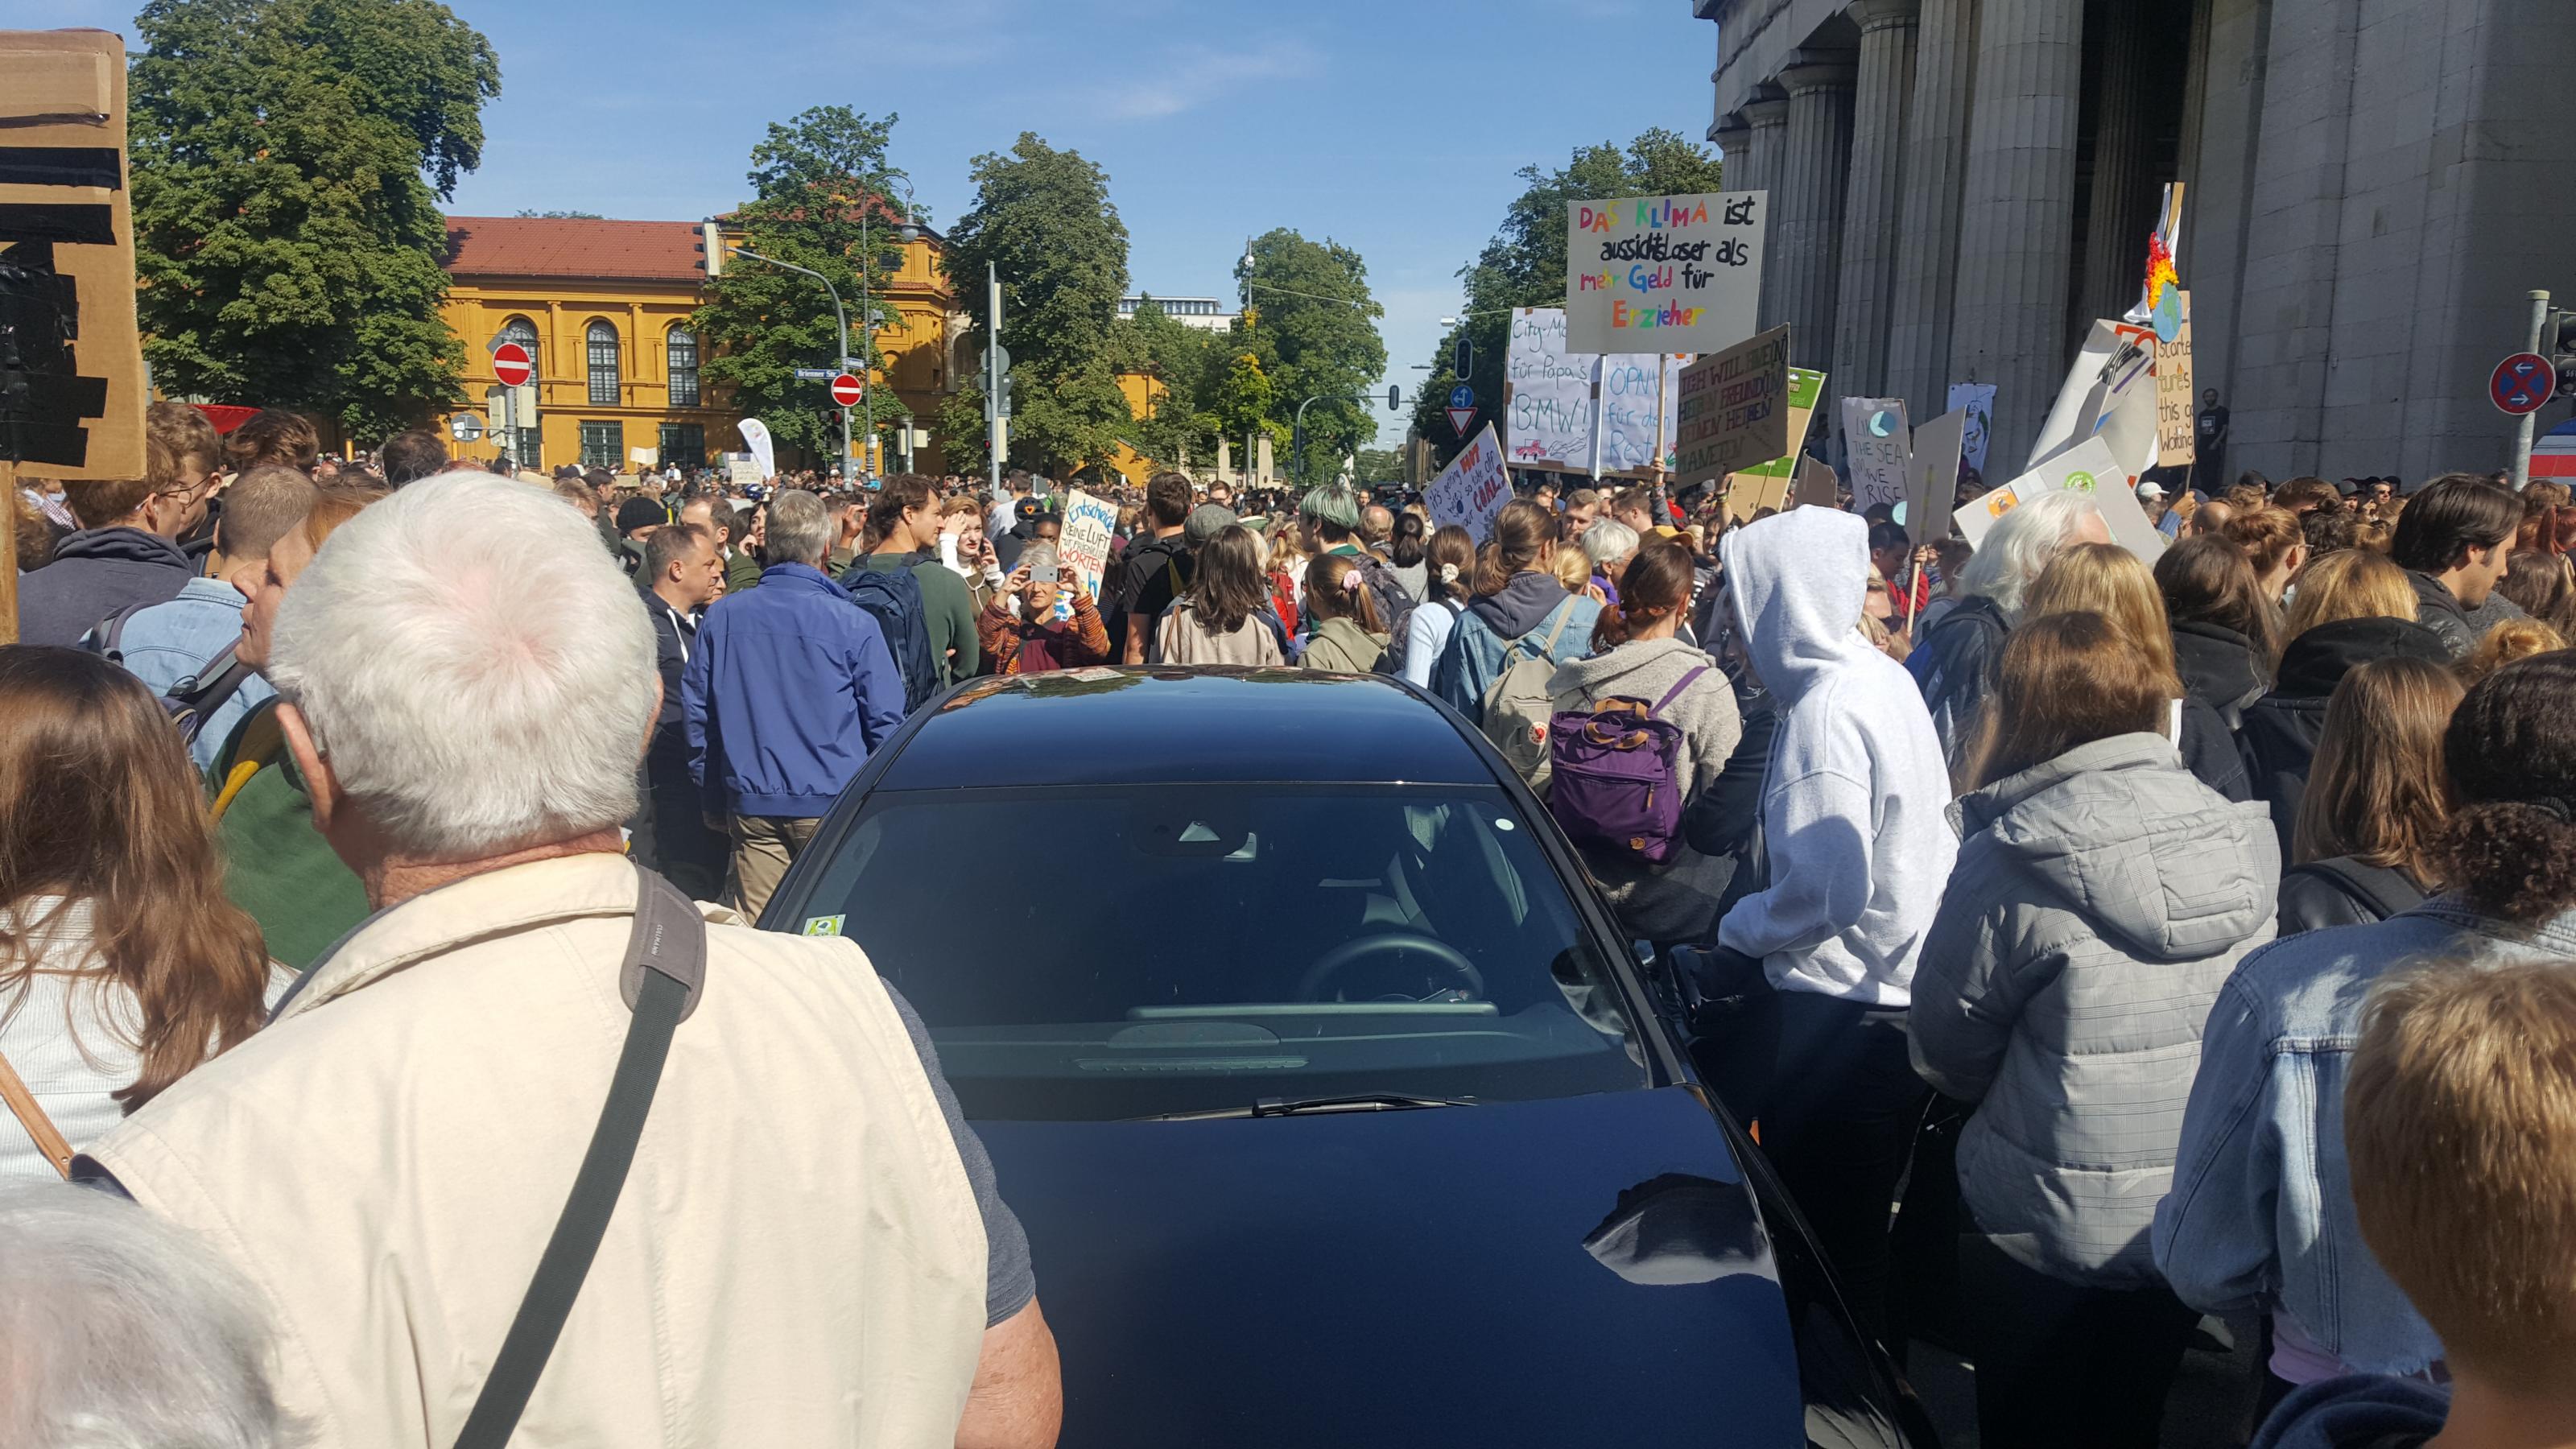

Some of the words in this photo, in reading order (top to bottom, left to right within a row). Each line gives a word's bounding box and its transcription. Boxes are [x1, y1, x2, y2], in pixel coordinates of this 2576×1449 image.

[1580, 201, 1621, 233] DAS
[1636, 199, 1708, 229] KLIMA
[1724, 196, 1756, 225] ist
[1716, 237, 1748, 266] als
[1580, 266, 1622, 291] mehr
[1629, 264, 1673, 294] Geld
[1682, 262, 1715, 289] für
[1612, 299, 1707, 328] Erzieher
[1512, 357, 1530, 380] für
[1681, 369, 1707, 397] ICH
[1711, 356, 1744, 386] WILL
[1515, 394, 1588, 433] BMW!
[1608, 402, 1635, 425] für
[2159, 397, 2180, 423] this
[1459, 443, 1480, 476] HOT
[1610, 430, 1653, 463] Rest
[1853, 441, 1872, 456] THE
[1877, 443, 1905, 468] SEA
[1086, 523, 1110, 549] LUFT
[1059, 548, 1107, 574] WORTEN
